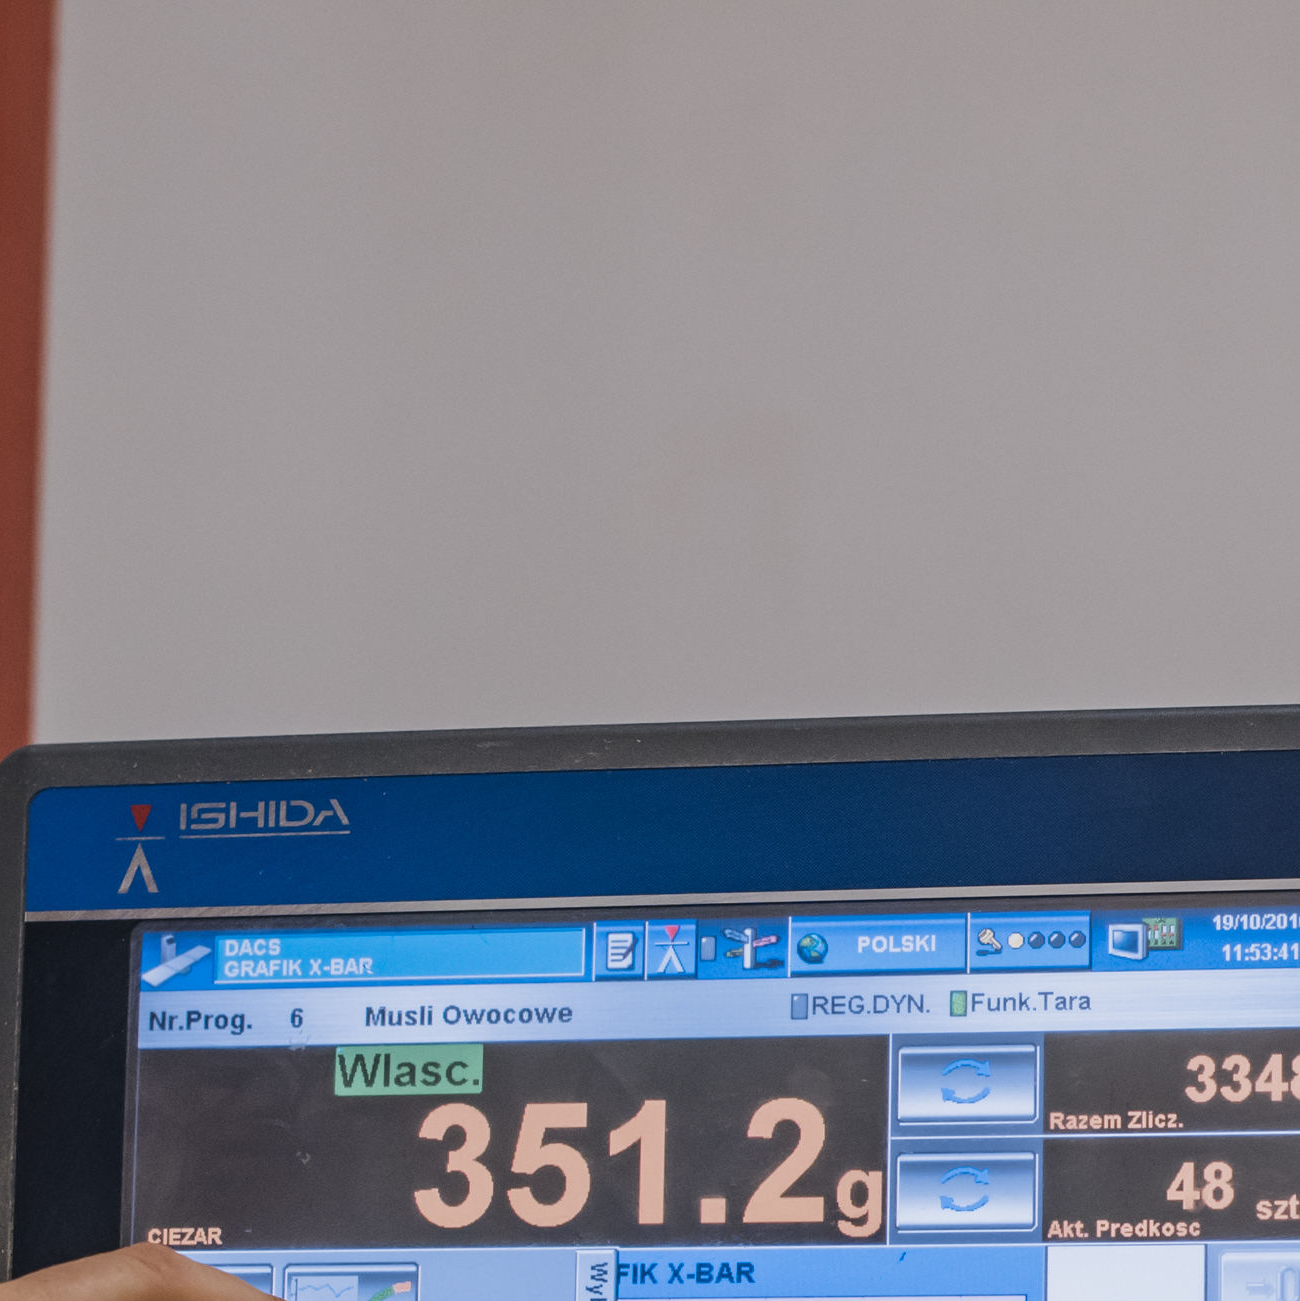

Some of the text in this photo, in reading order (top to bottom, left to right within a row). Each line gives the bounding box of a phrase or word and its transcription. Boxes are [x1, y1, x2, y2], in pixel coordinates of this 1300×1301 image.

[180, 799, 350, 830] ISHIDA
[224, 939, 280, 957] DACS
[857, 935, 937, 954] POLSKI
[1222, 943, 1300, 961] 11:53:41
[223, 957, 374, 978] GRAFIK X-BAR
[811, 994, 930, 1015] REG.DYN.
[971, 991, 1091, 1012] Funk.Tara
[148, 1008, 303, 1034] Nr.Prog. 6
[365, 1004, 573, 1027] Musli Owocowe
[337, 1053, 480, 1088] Wlasc.
[1049, 1109, 1183, 1130] Razem Zlicz.
[1166, 1161, 1235, 1210] 48
[148, 1227, 222, 1245] CIEZAR
[1048, 1218, 1201, 1239] Akt. Predkosc
[617, 1262, 755, 1285] FIK X-BAR
